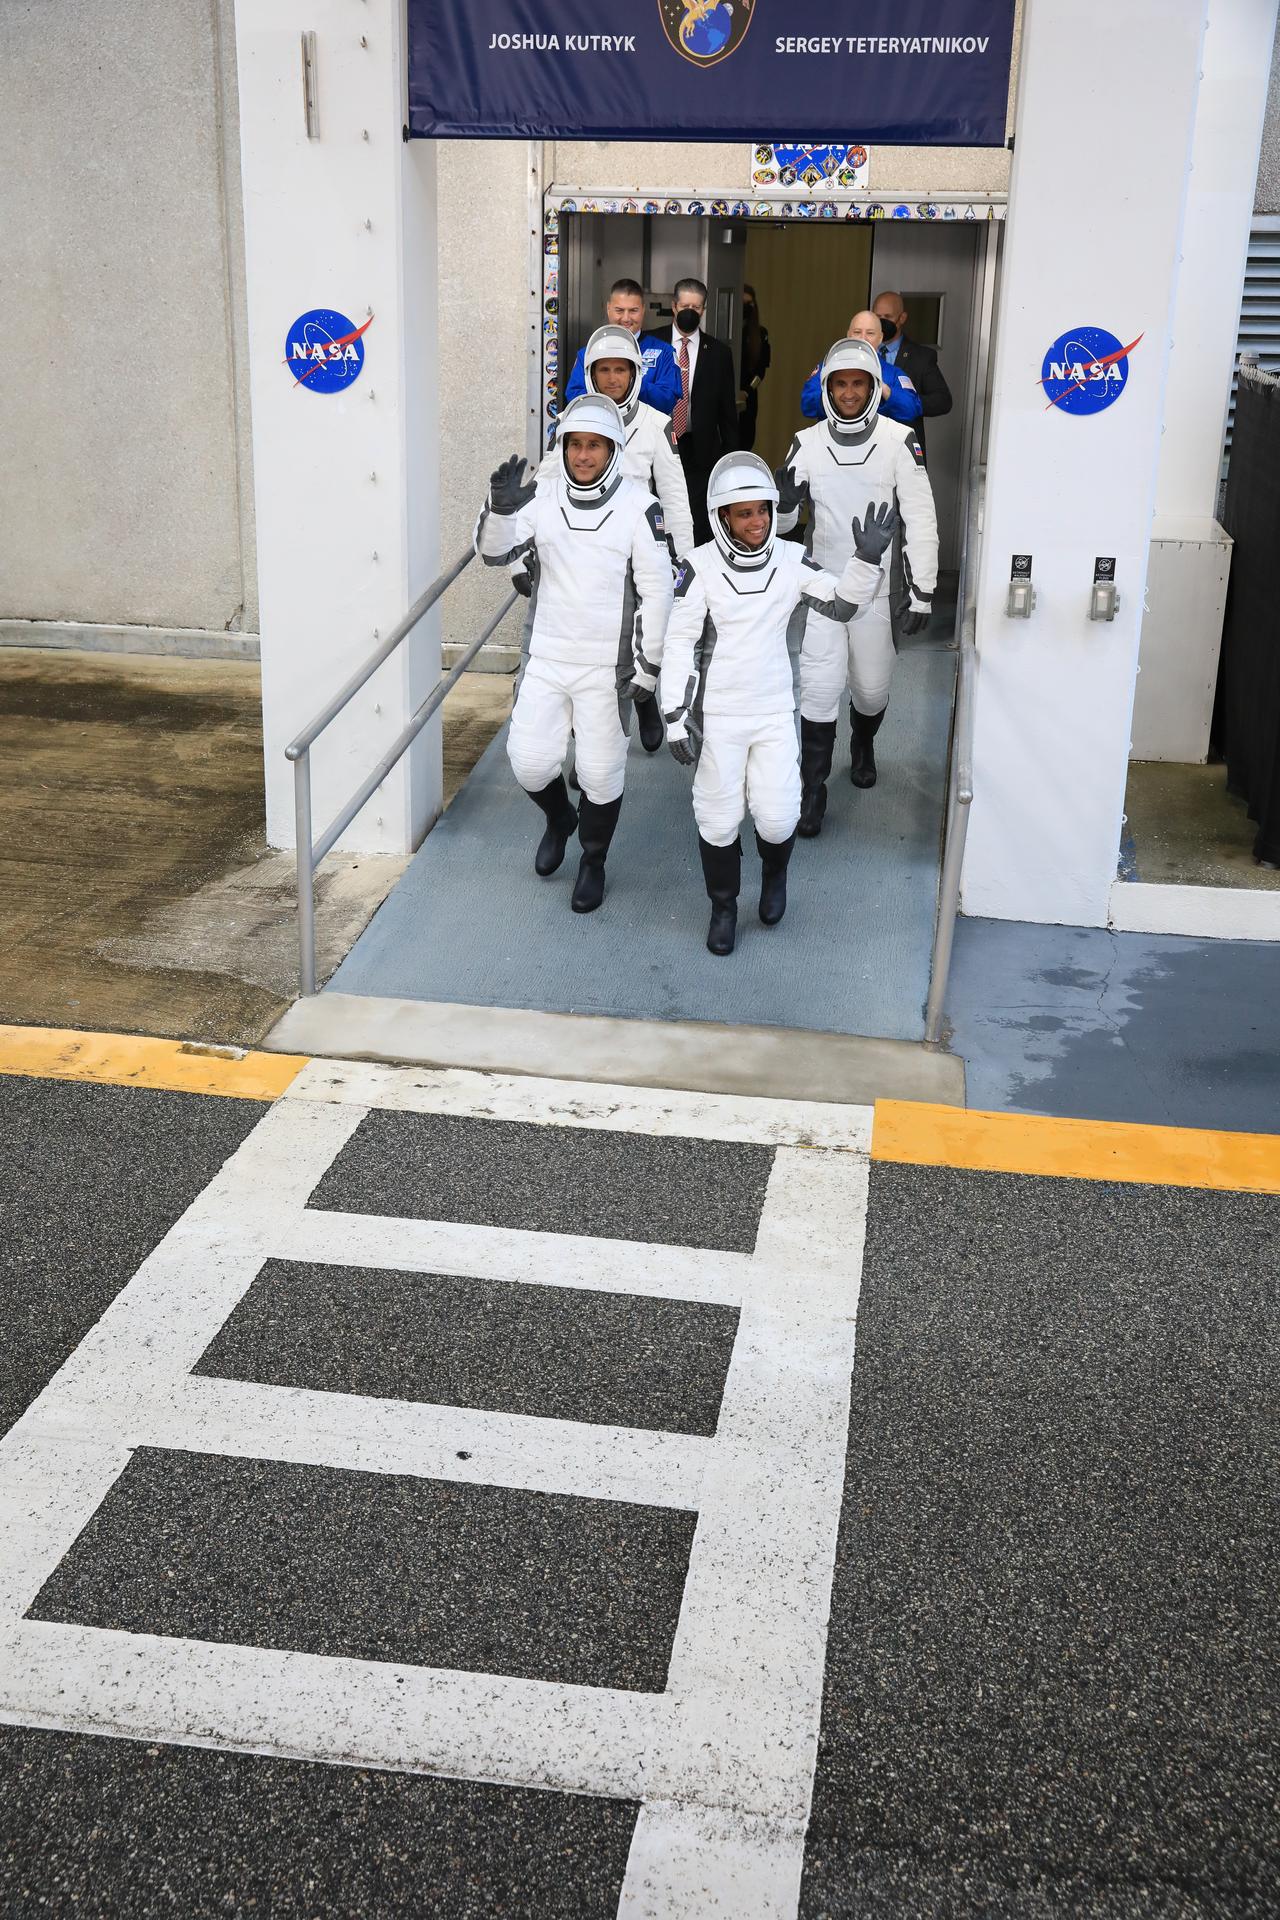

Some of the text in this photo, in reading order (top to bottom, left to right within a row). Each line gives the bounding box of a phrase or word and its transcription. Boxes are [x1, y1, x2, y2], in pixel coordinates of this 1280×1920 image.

[488, 33, 636, 52] JOSHUA KUTRYK
[775, 37, 990, 53] SERGEY TETERYATNIKOV
[291, 342, 360, 361] NASA
[1048, 362, 1123, 381] NASA
